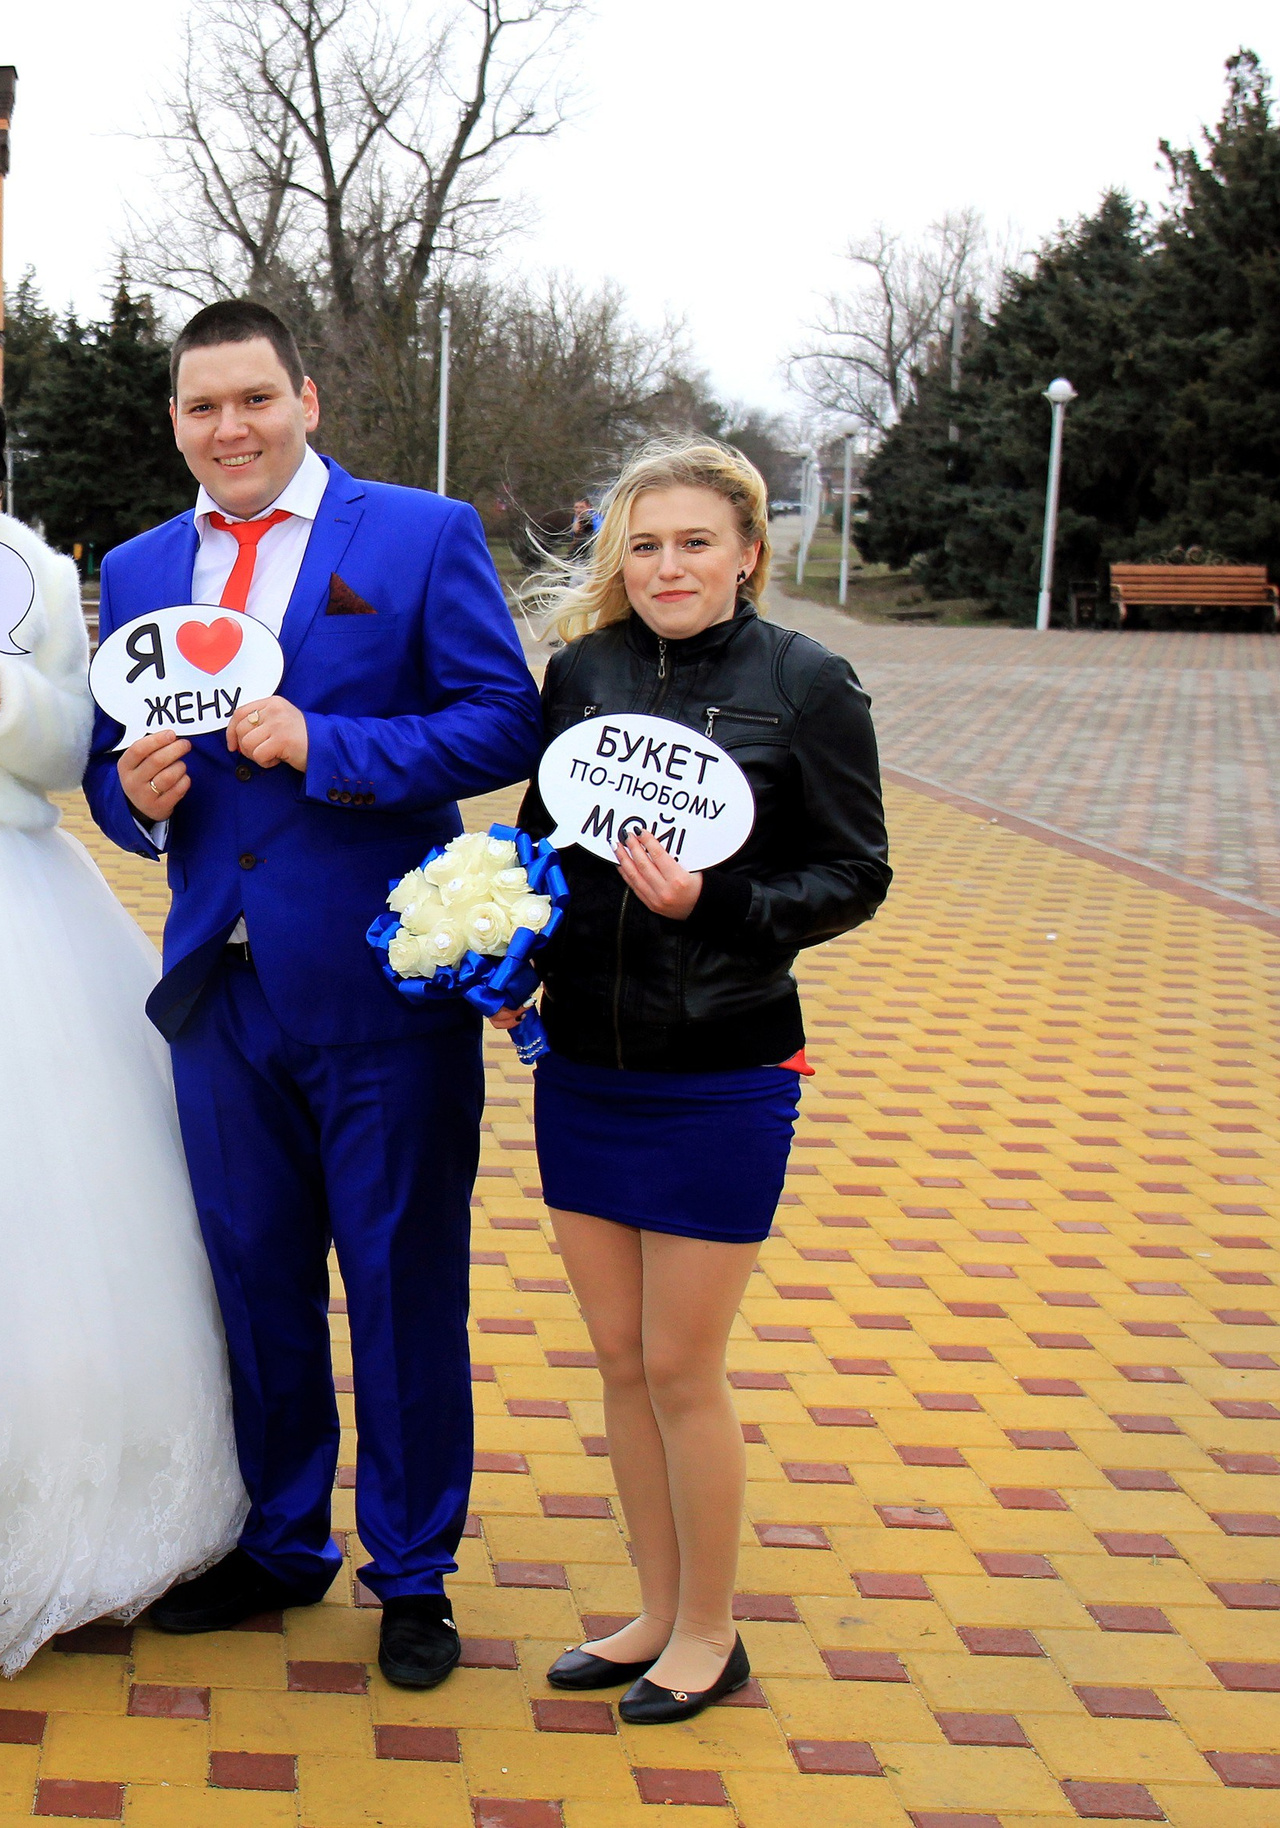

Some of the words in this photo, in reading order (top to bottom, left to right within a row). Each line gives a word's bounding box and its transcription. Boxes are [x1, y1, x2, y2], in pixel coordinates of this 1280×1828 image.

[126, 623, 165, 683] Я
[144, 687, 242, 727] ЖЕНУ
[596, 725, 719, 784] БУКЕТ
[570, 759, 726, 820] ПО-ЛЮБОМУ
